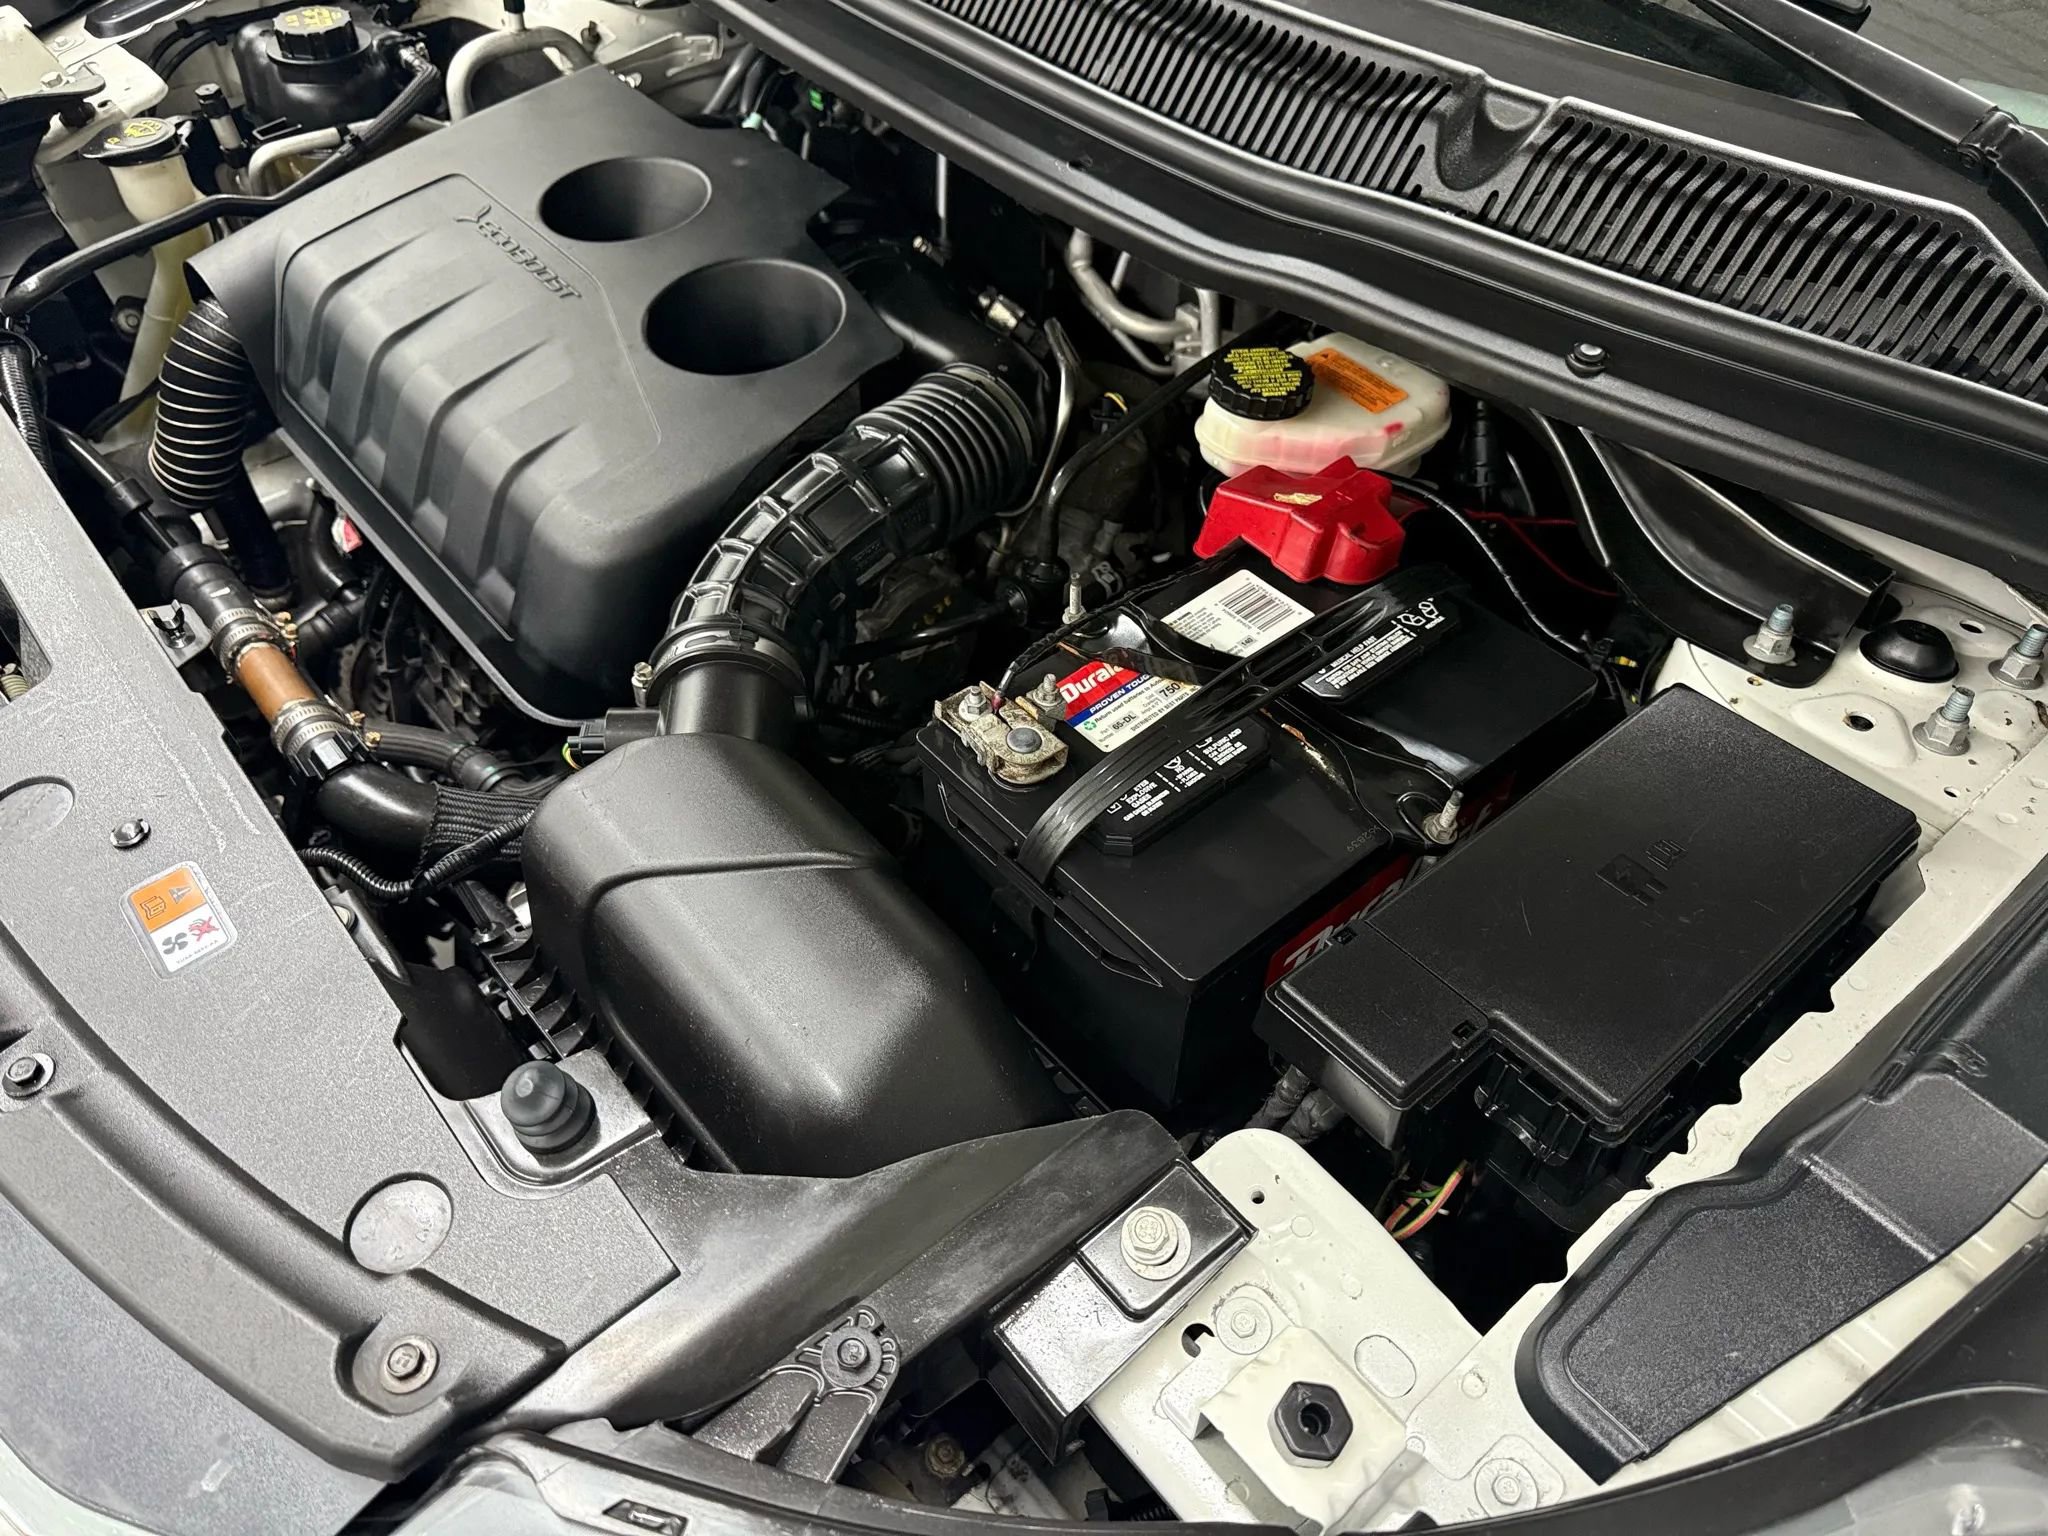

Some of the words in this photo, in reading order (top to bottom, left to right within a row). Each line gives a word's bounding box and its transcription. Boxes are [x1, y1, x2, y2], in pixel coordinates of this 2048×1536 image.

[1350, 643, 1365, 654] HELP
[1089, 689, 1127, 714] PROVEN
[1127, 673, 1151, 693] TOUG
[1159, 681, 1181, 698] 750
[1094, 708, 1112, 723] Return
[1112, 702, 1124, 714] used
[1123, 690, 1145, 707] batteries
[1130, 711, 1159, 732] DISTRIBUTED
[1165, 700, 1177, 710] BEST
[1112, 712, 1137, 731] 65-DL
[1202, 736, 1230, 754] SULFURIC
[1228, 728, 1243, 740] ACID
[1174, 764, 1186, 774] NO
[1125, 781, 1158, 804] EXPLOSIVE
[1131, 793, 1152, 809] GASES
